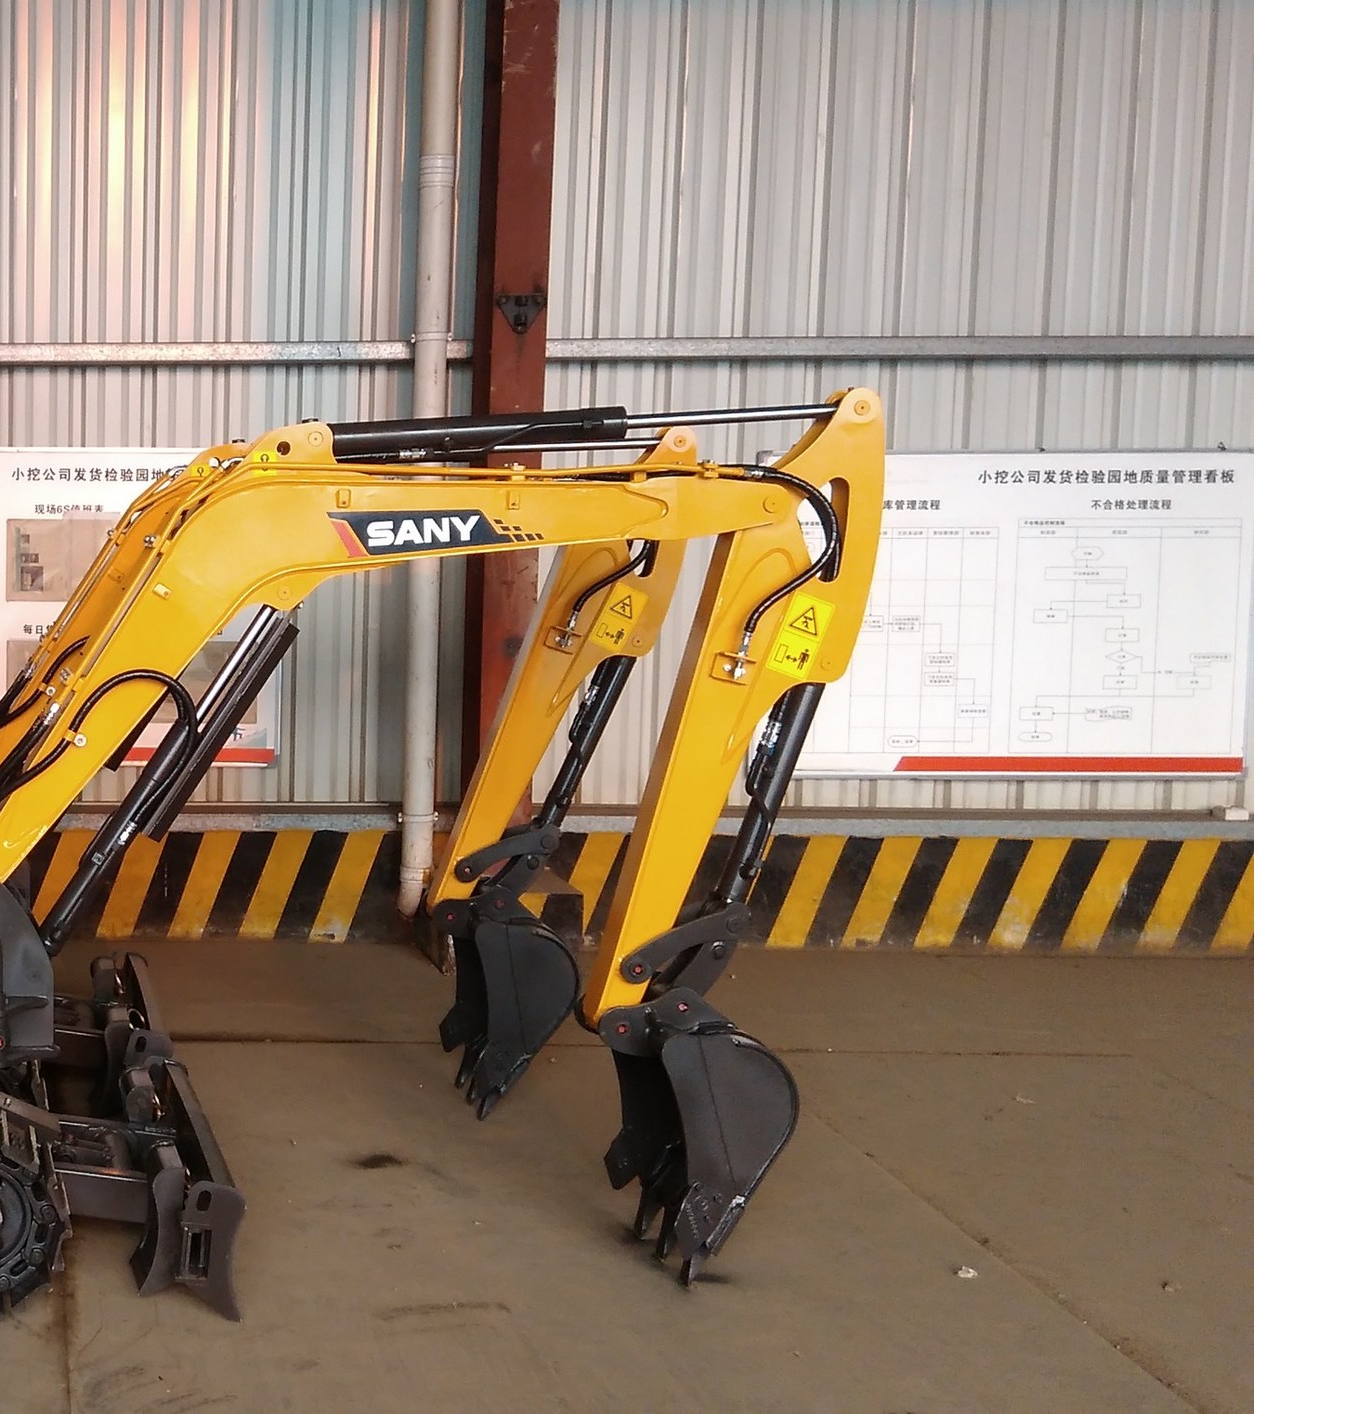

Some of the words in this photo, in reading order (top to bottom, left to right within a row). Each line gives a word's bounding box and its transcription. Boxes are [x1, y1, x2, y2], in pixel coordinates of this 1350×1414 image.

[978, 469, 1236, 484] 小挖公司发货检验园地质量管理看板
[1090, 499, 1172, 511] 不合格处理流程
[366, 515, 480, 547] SANY
